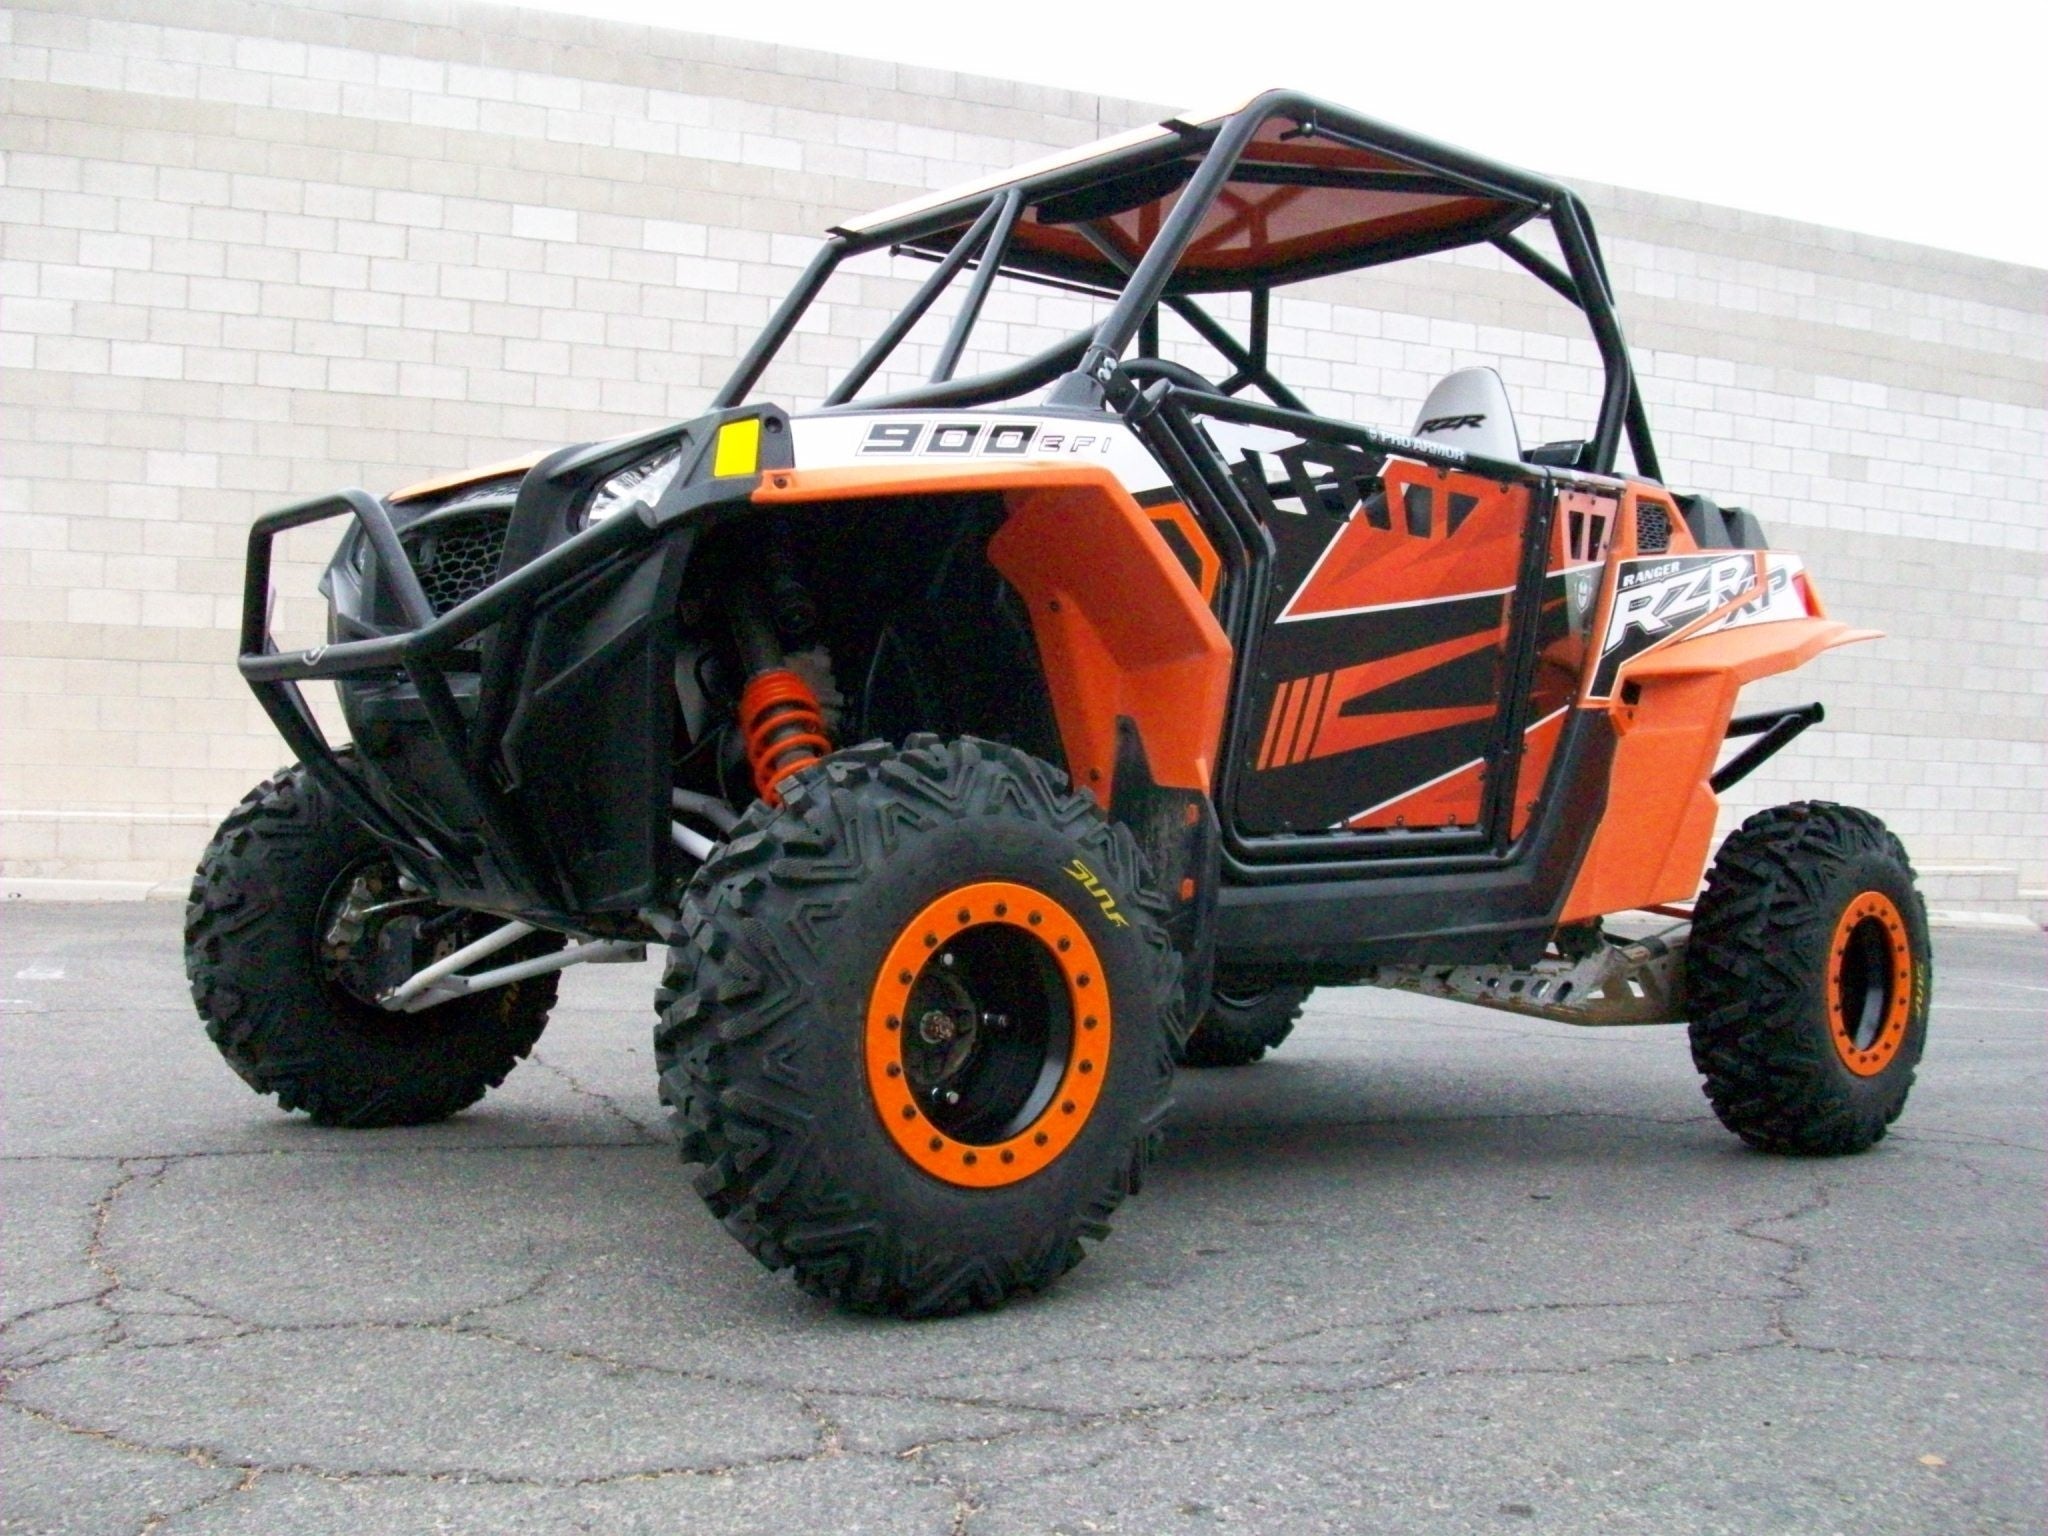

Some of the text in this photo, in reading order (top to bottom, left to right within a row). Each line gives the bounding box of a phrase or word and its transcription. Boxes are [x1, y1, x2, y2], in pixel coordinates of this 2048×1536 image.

[857, 421, 1112, 456] 900 EFI
[1414, 413, 1487, 437] RZR
[1381, 430, 1466, 461] PRO ARMOR
[1623, 560, 1681, 588] RANGER
[1602, 554, 1757, 653] RZR
